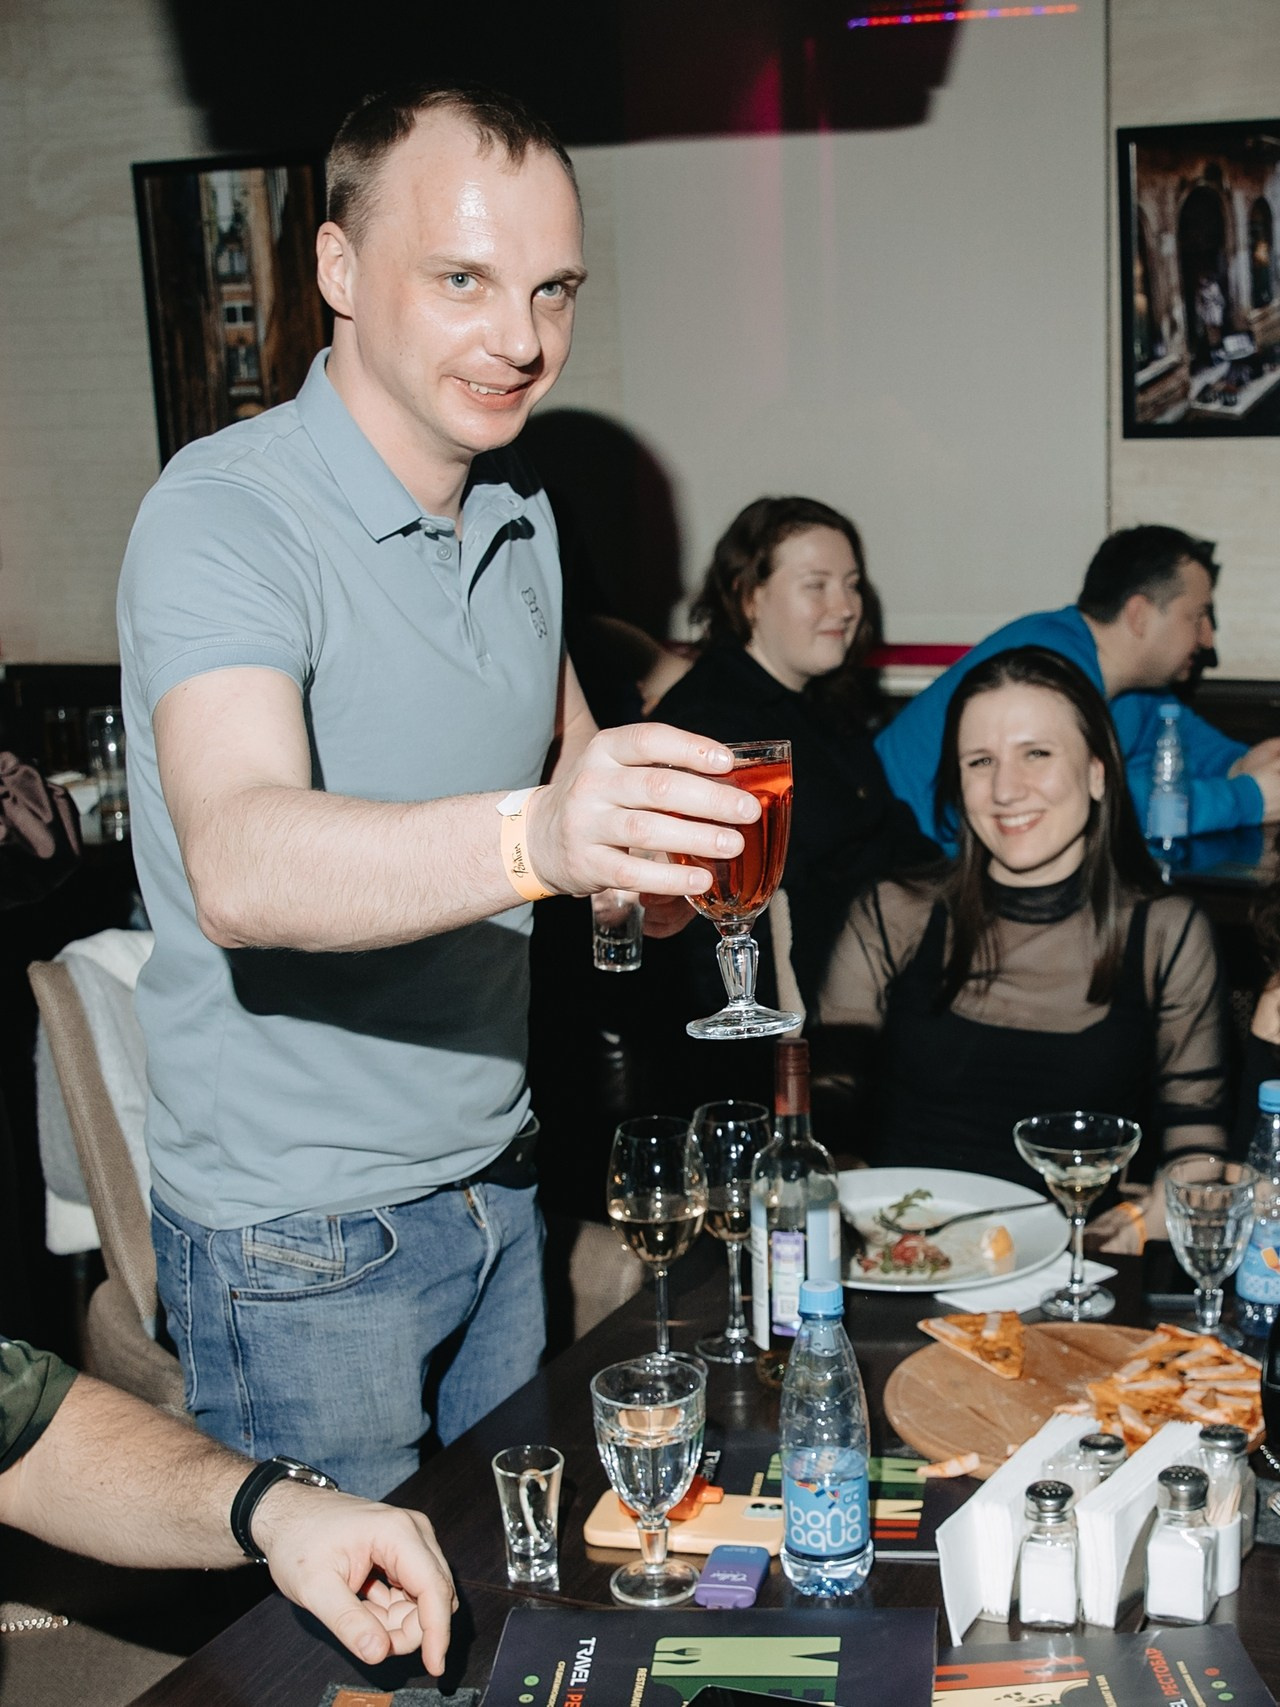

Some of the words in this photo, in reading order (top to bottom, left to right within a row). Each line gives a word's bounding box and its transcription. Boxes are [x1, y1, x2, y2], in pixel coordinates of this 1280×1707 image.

[789, 1500, 862, 1530] bona
[790, 1523, 862, 1553] aqua
[569, 1636, 597, 1687] TRAVEL
[1145, 1647, 1180, 1697] РЕСТОБАР
